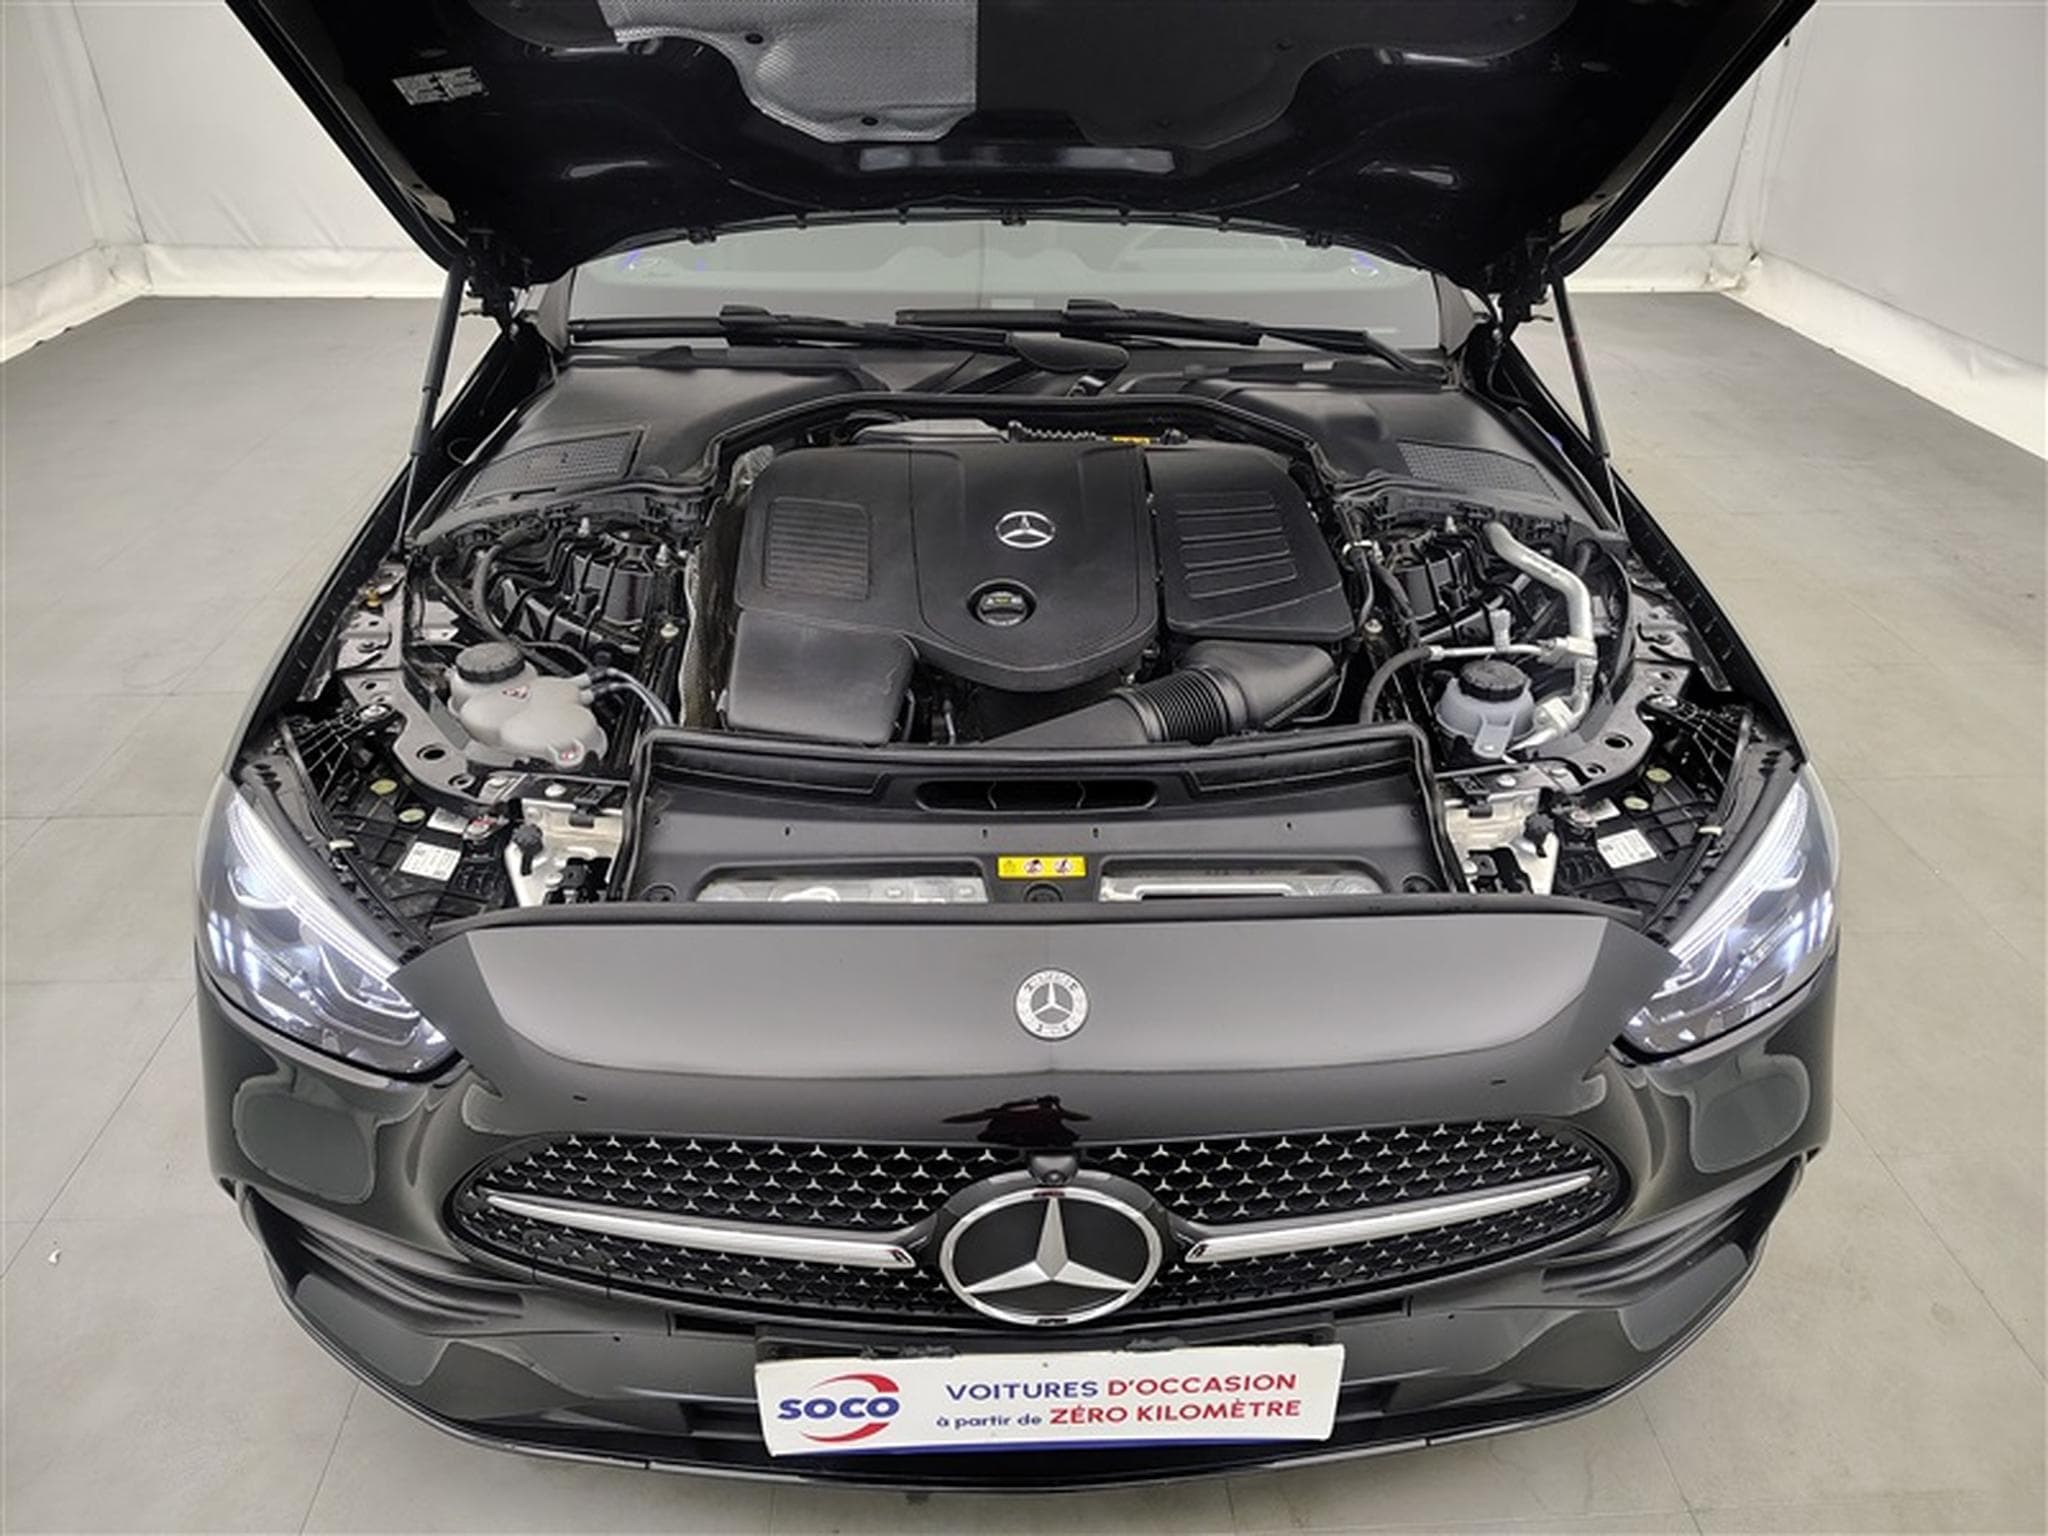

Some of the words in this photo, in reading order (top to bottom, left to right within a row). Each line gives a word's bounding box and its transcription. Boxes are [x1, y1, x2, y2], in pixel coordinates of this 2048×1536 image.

[946, 1381, 1099, 1400] VOITURES
[1108, 1374, 1297, 1396] D'OCCASION
[777, 1396, 900, 1420] SOCO
[936, 1415, 949, 1427] à
[954, 1414, 1011, 1429] partir
[1017, 1413, 1042, 1426] de
[1050, 1405, 1129, 1424] ZÉRO
[1136, 1398, 1302, 1422] KILOMÈTRE
